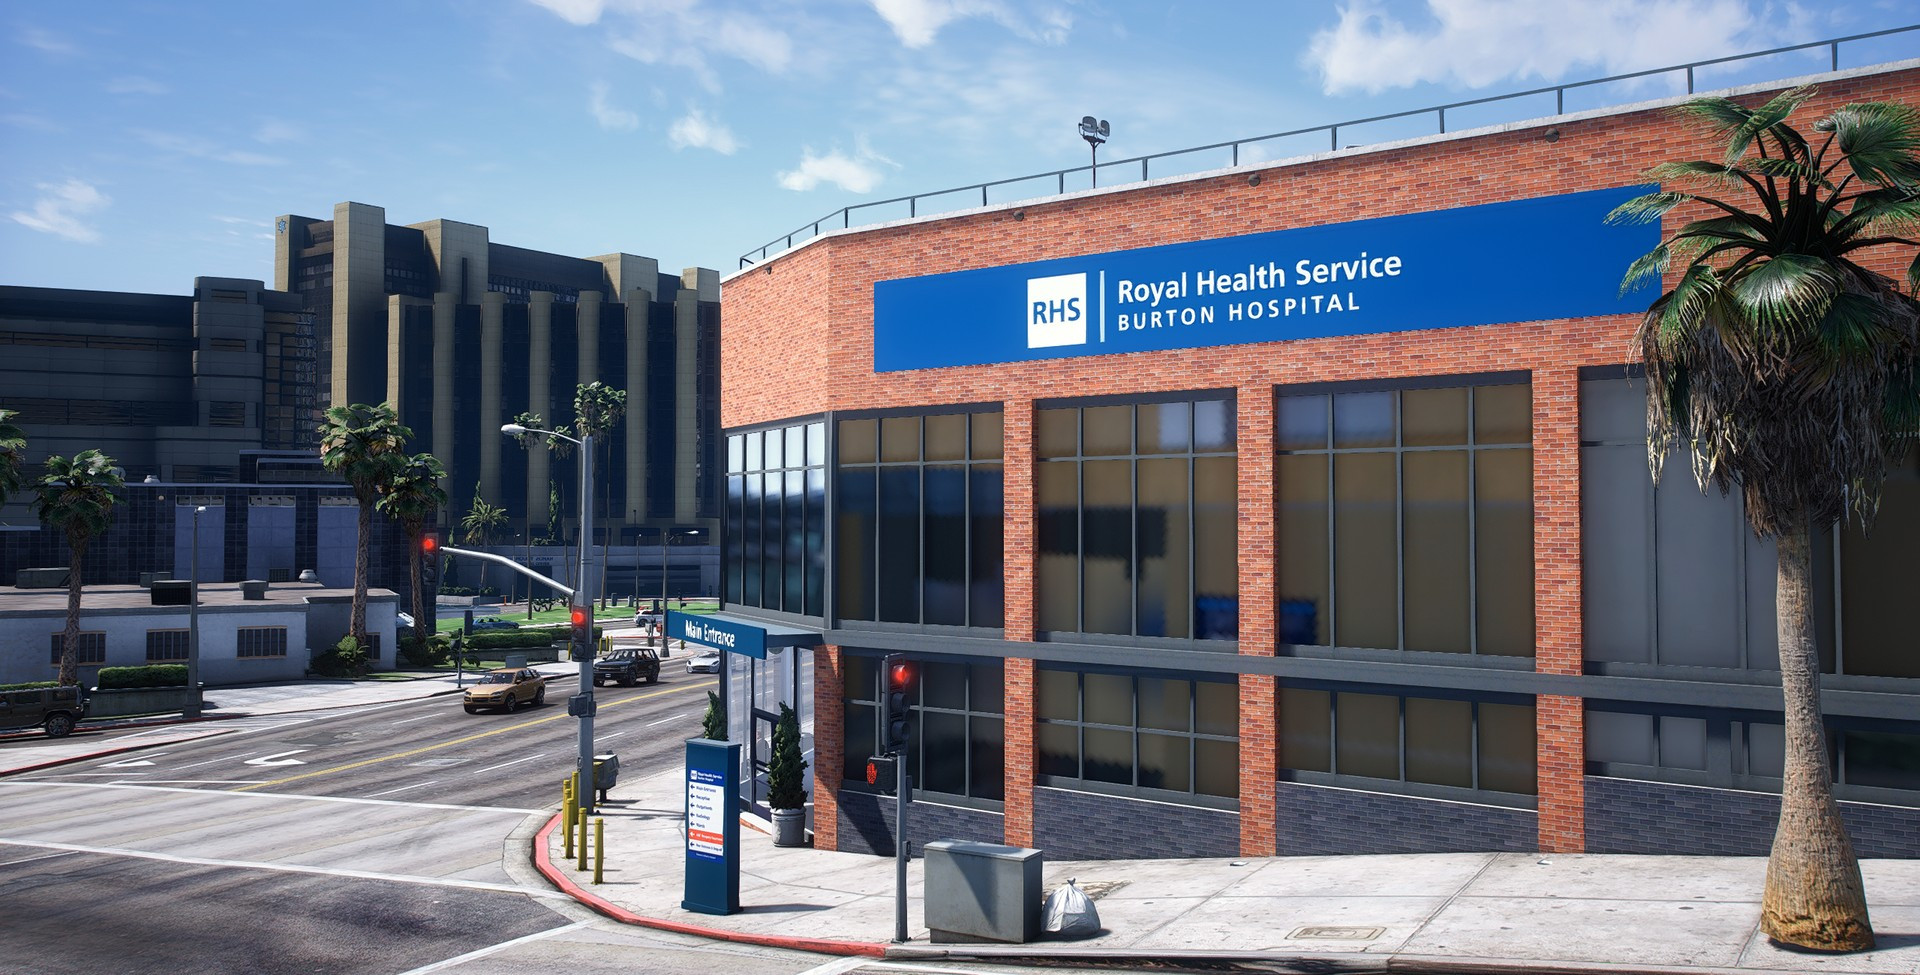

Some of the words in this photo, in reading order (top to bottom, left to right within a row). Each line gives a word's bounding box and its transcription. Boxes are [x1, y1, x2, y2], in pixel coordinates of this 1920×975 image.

[1119, 272, 1186, 306] Royal
[1198, 262, 1284, 295] Health
[1296, 252, 1401, 285] Service
[1034, 298, 1080, 324] RHS
[1119, 306, 1213, 330] BURTON
[1230, 293, 1359, 320] HOSPITAL
[686, 620, 702, 639] Main
[704, 624, 734, 647] Entrance
